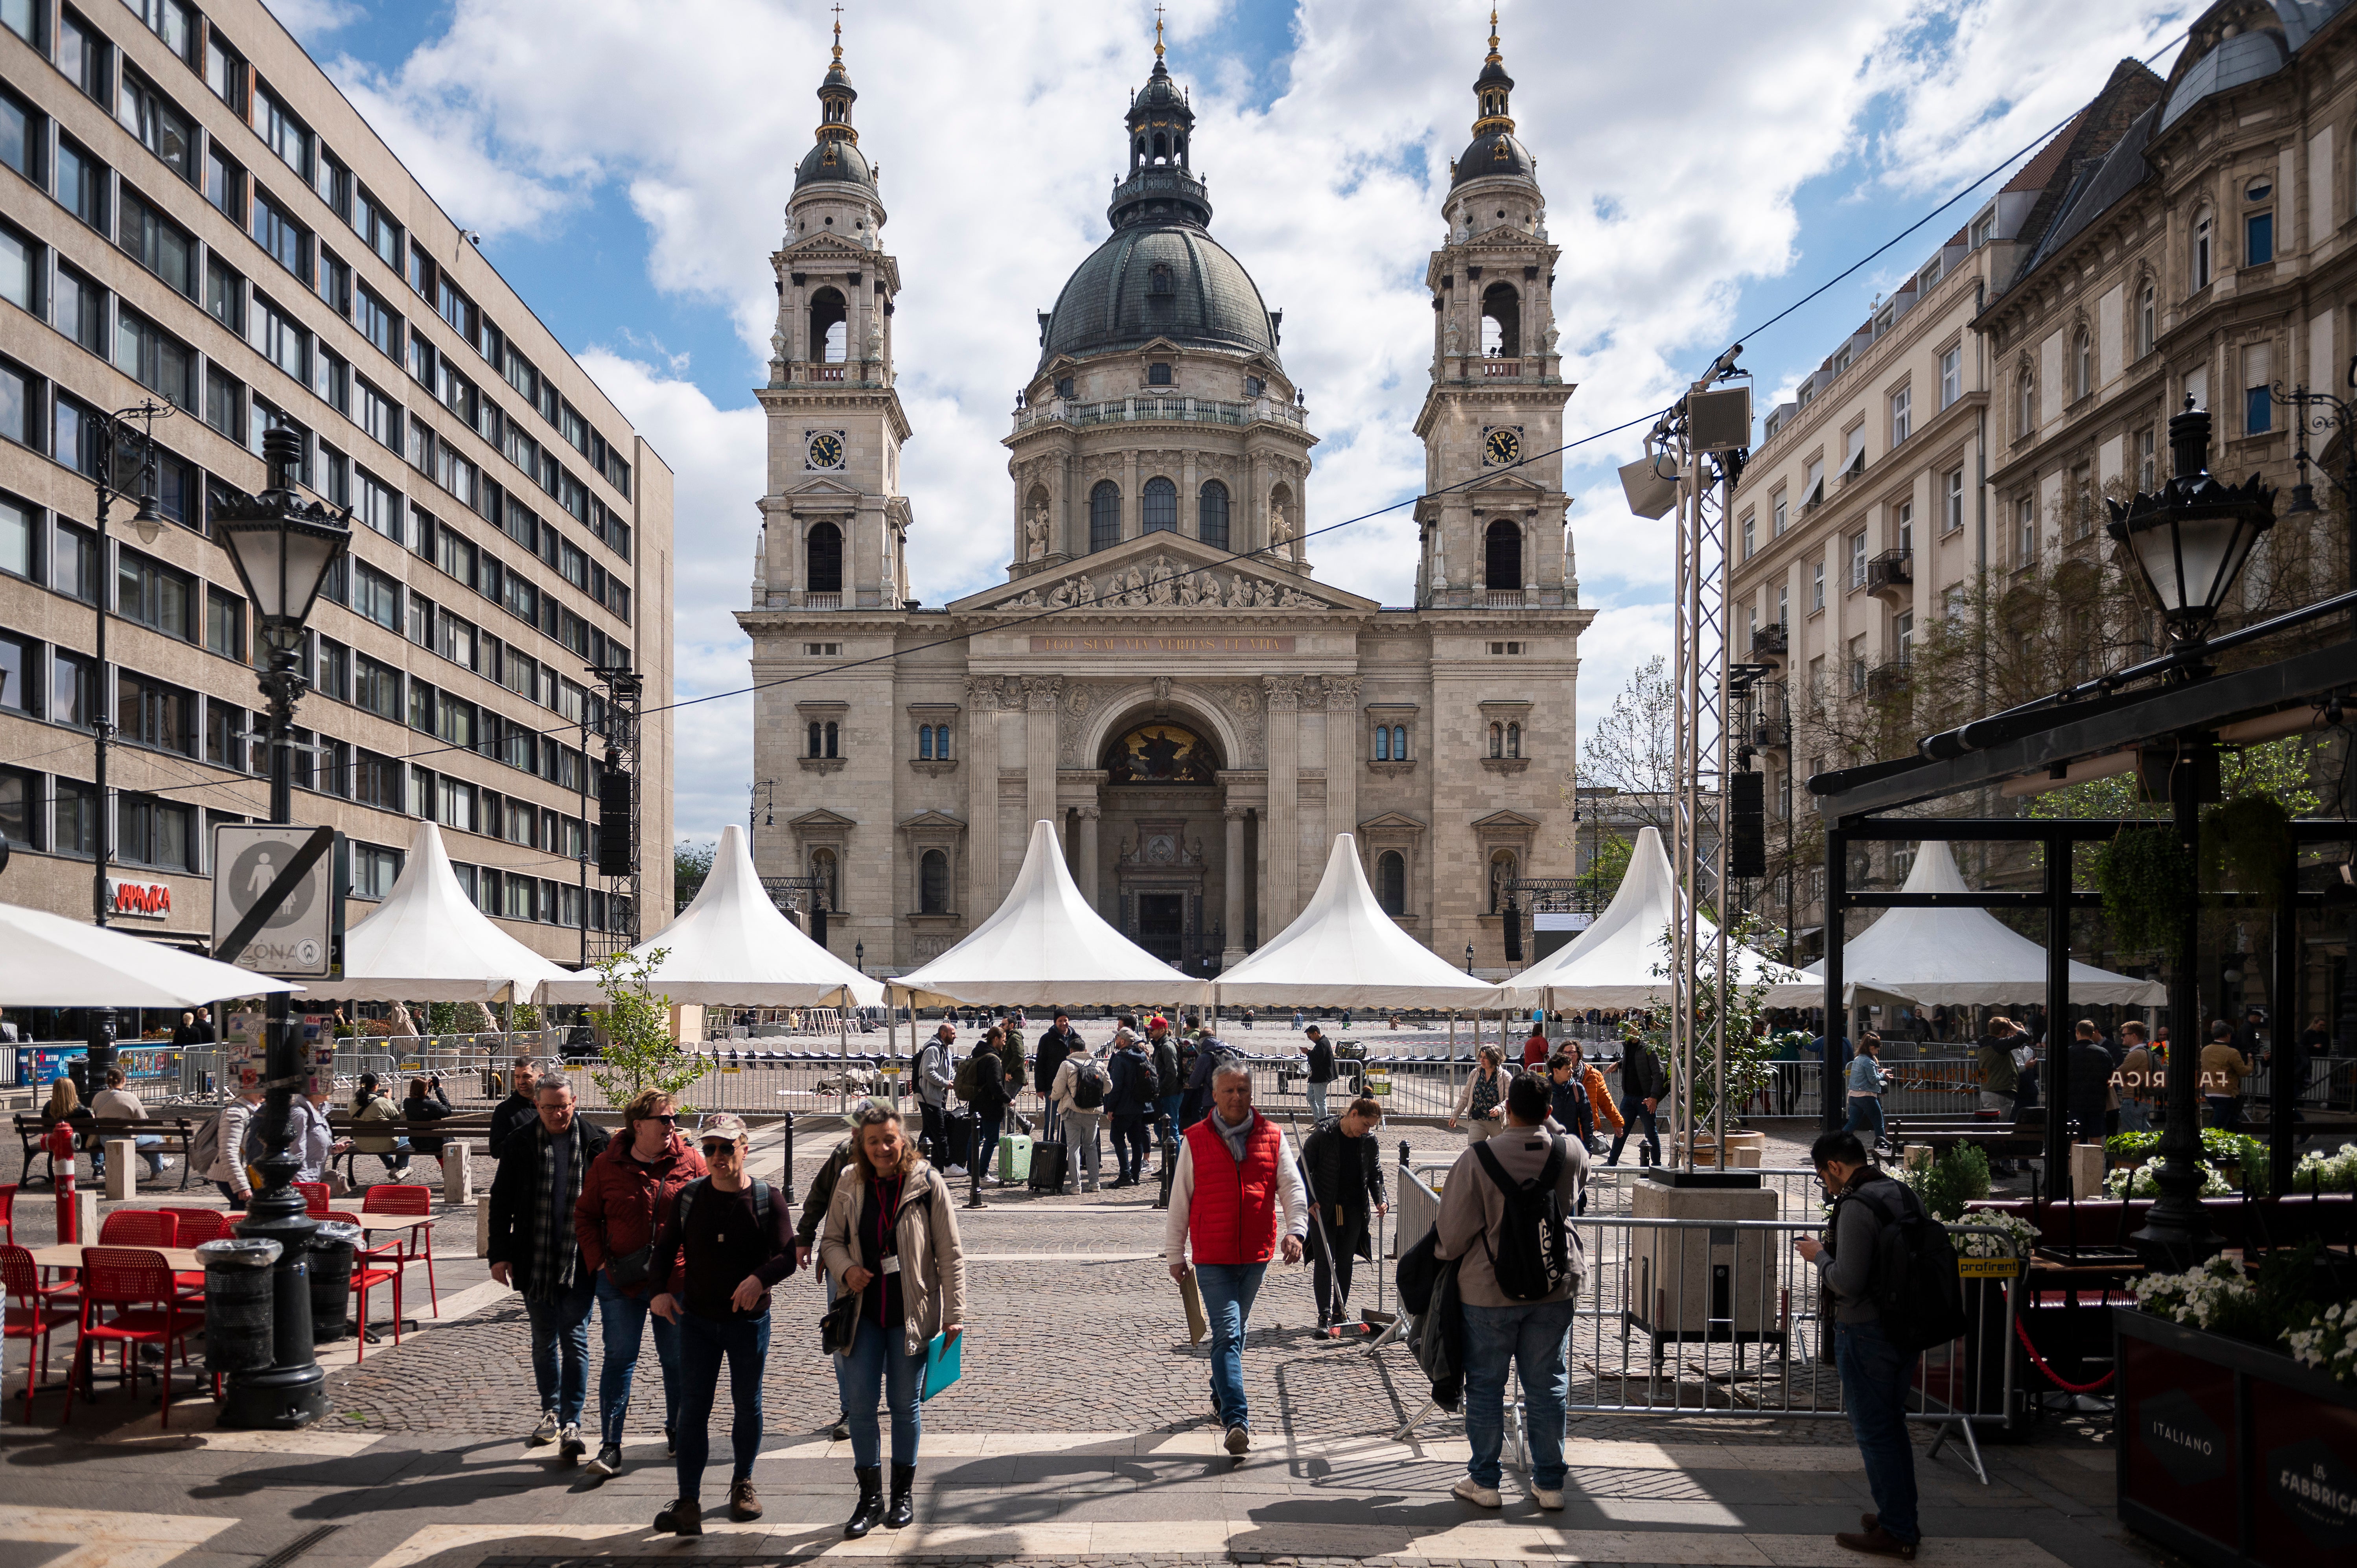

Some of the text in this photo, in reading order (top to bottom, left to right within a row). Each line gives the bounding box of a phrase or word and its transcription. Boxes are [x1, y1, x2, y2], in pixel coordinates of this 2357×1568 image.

[1045, 639, 1280, 650] EGO SUM VIA VERITAS ET VITA
[709, 1115, 728, 1126] SF
[1961, 1261, 2016, 1273] profirent
[2153, 1421, 2212, 1456] ITALIANO
[2313, 1463, 2327, 1480] LA
[2280, 1469, 2357, 1516] FABBRICA
